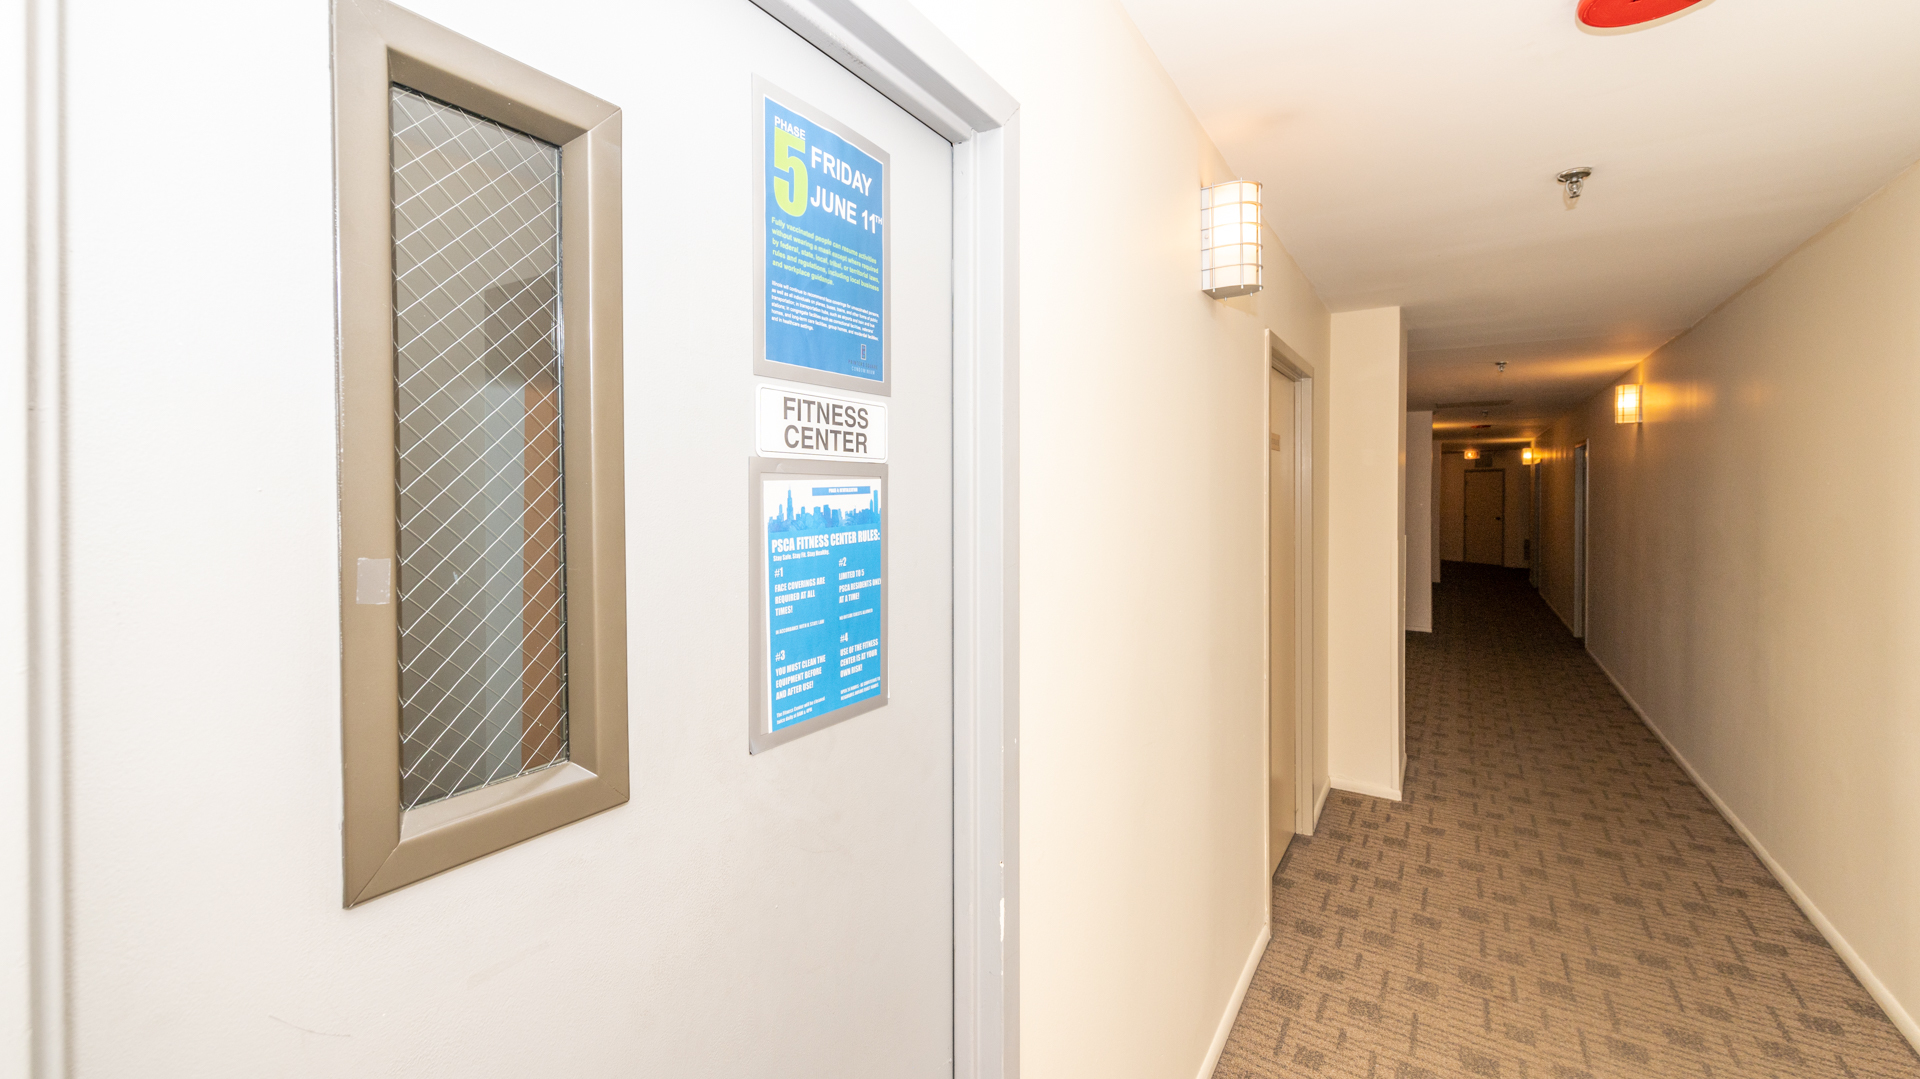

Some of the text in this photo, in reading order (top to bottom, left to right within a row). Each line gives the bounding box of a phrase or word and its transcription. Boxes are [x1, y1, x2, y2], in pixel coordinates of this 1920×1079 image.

[775, 116, 806, 140] PHASE
[774, 126, 808, 217] 5
[812, 146, 872, 196] FRIDAY
[810, 185, 882, 234] JUNE 11TH
[772, 216, 786, 229] Fully
[786, 224, 814, 239] vaccinated
[814, 235, 832, 246] people
[842, 246, 858, 256] resume
[858, 253, 876, 264] activities
[772, 228, 792, 241] without
[793, 236, 814, 250] wearing
[818, 246, 832, 256] mask
[832, 252, 848, 262] except
[848, 258, 862, 267] where
[862, 263, 878, 274] required
[772, 238, 779, 248] by
[780, 240, 800, 254] federal,
[801, 250, 816, 260] state,
[816, 254, 829, 265] local,
[830, 260, 843, 270] tribal,
[849, 266, 869, 279] territorial
[869, 274, 880, 284] laws,
[772, 250, 880, 292] rules and regulations, including local business
[772, 260, 834, 286] and workplace guidance.
[783, 396, 869, 430] FITNESS
[784, 424, 868, 454] CENTER
[772, 529, 880, 554] PSCA FITNESS CENTER RULES:
[838, 556, 847, 567] #2
[774, 567, 783, 578] #1
[839, 570, 855, 580] LIMITED
[856, 569, 861, 577] TO
[775, 576, 825, 593] FACE COVERINGS ARE
[839, 584, 850, 593] PSCA
[851, 579, 872, 590] RESIDENTS
[775, 590, 815, 604] REQUIRED AT ALL
[839, 595, 844, 604] AT
[848, 592, 859, 601] TIME!
[775, 605, 793, 616] TIMES!
[840, 632, 848, 643] #4
[840, 647, 848, 656] USE
[849, 645, 854, 654] OF
[863, 638, 878, 650] FITNESS
[775, 650, 785, 662] #3
[775, 654, 826, 677] YOU MUST CLEAN THE
[840, 655, 856, 667] CENTER
[861, 652, 866, 660] AT
[867, 649, 877, 658] YOUR
[776, 666, 822, 689] EQUIPMENT BEFORE
[840, 664, 862, 678] OWN RISK!
[776, 680, 814, 700] AND AFTER USE!
